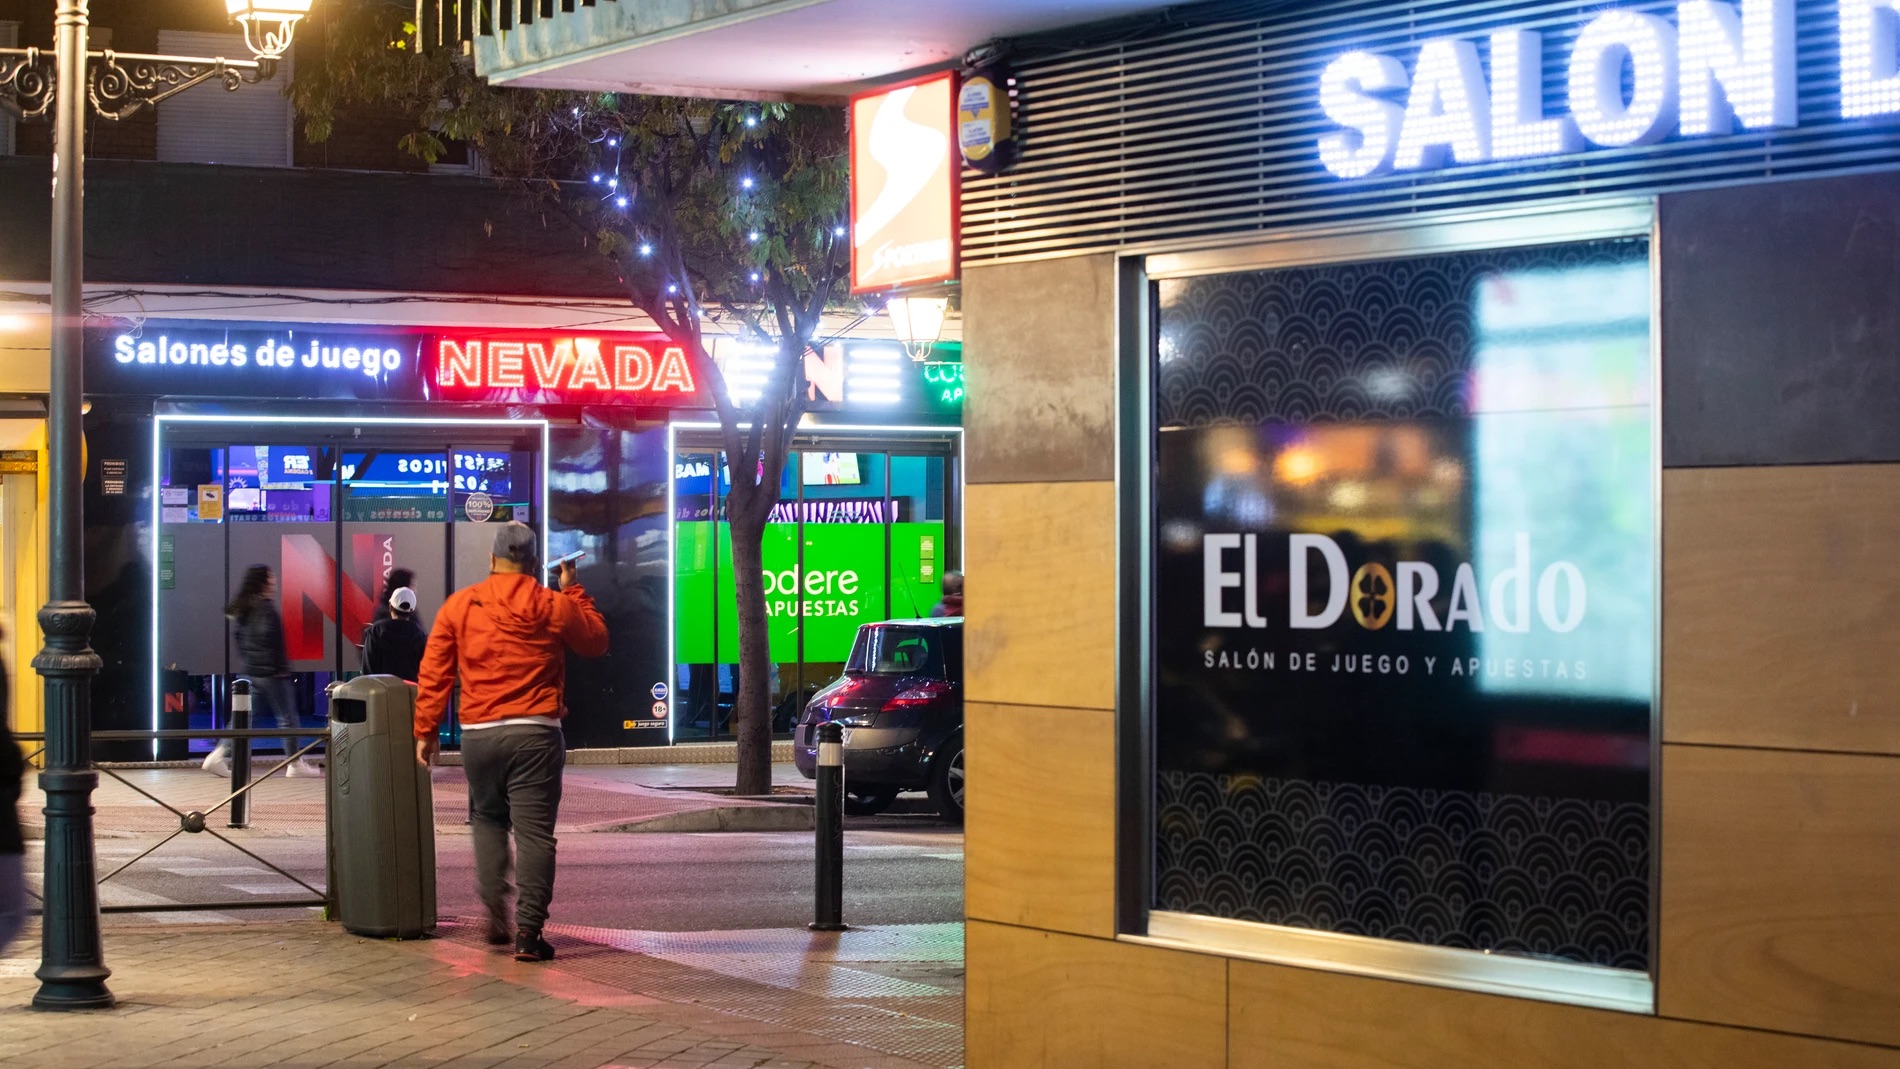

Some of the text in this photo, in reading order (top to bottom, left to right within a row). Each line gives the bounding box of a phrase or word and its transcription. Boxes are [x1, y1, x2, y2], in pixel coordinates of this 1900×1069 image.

[1318, 0, 1797, 179] SALON
[114, 335, 247, 366] Salones
[255, 339, 295, 367] de
[438, 340, 695, 392] NEVADA
[765, 599, 859, 617] APUESTAS
[1204, 647, 1586, 680] SALÓN DE JUEGO Y APUESTAS
